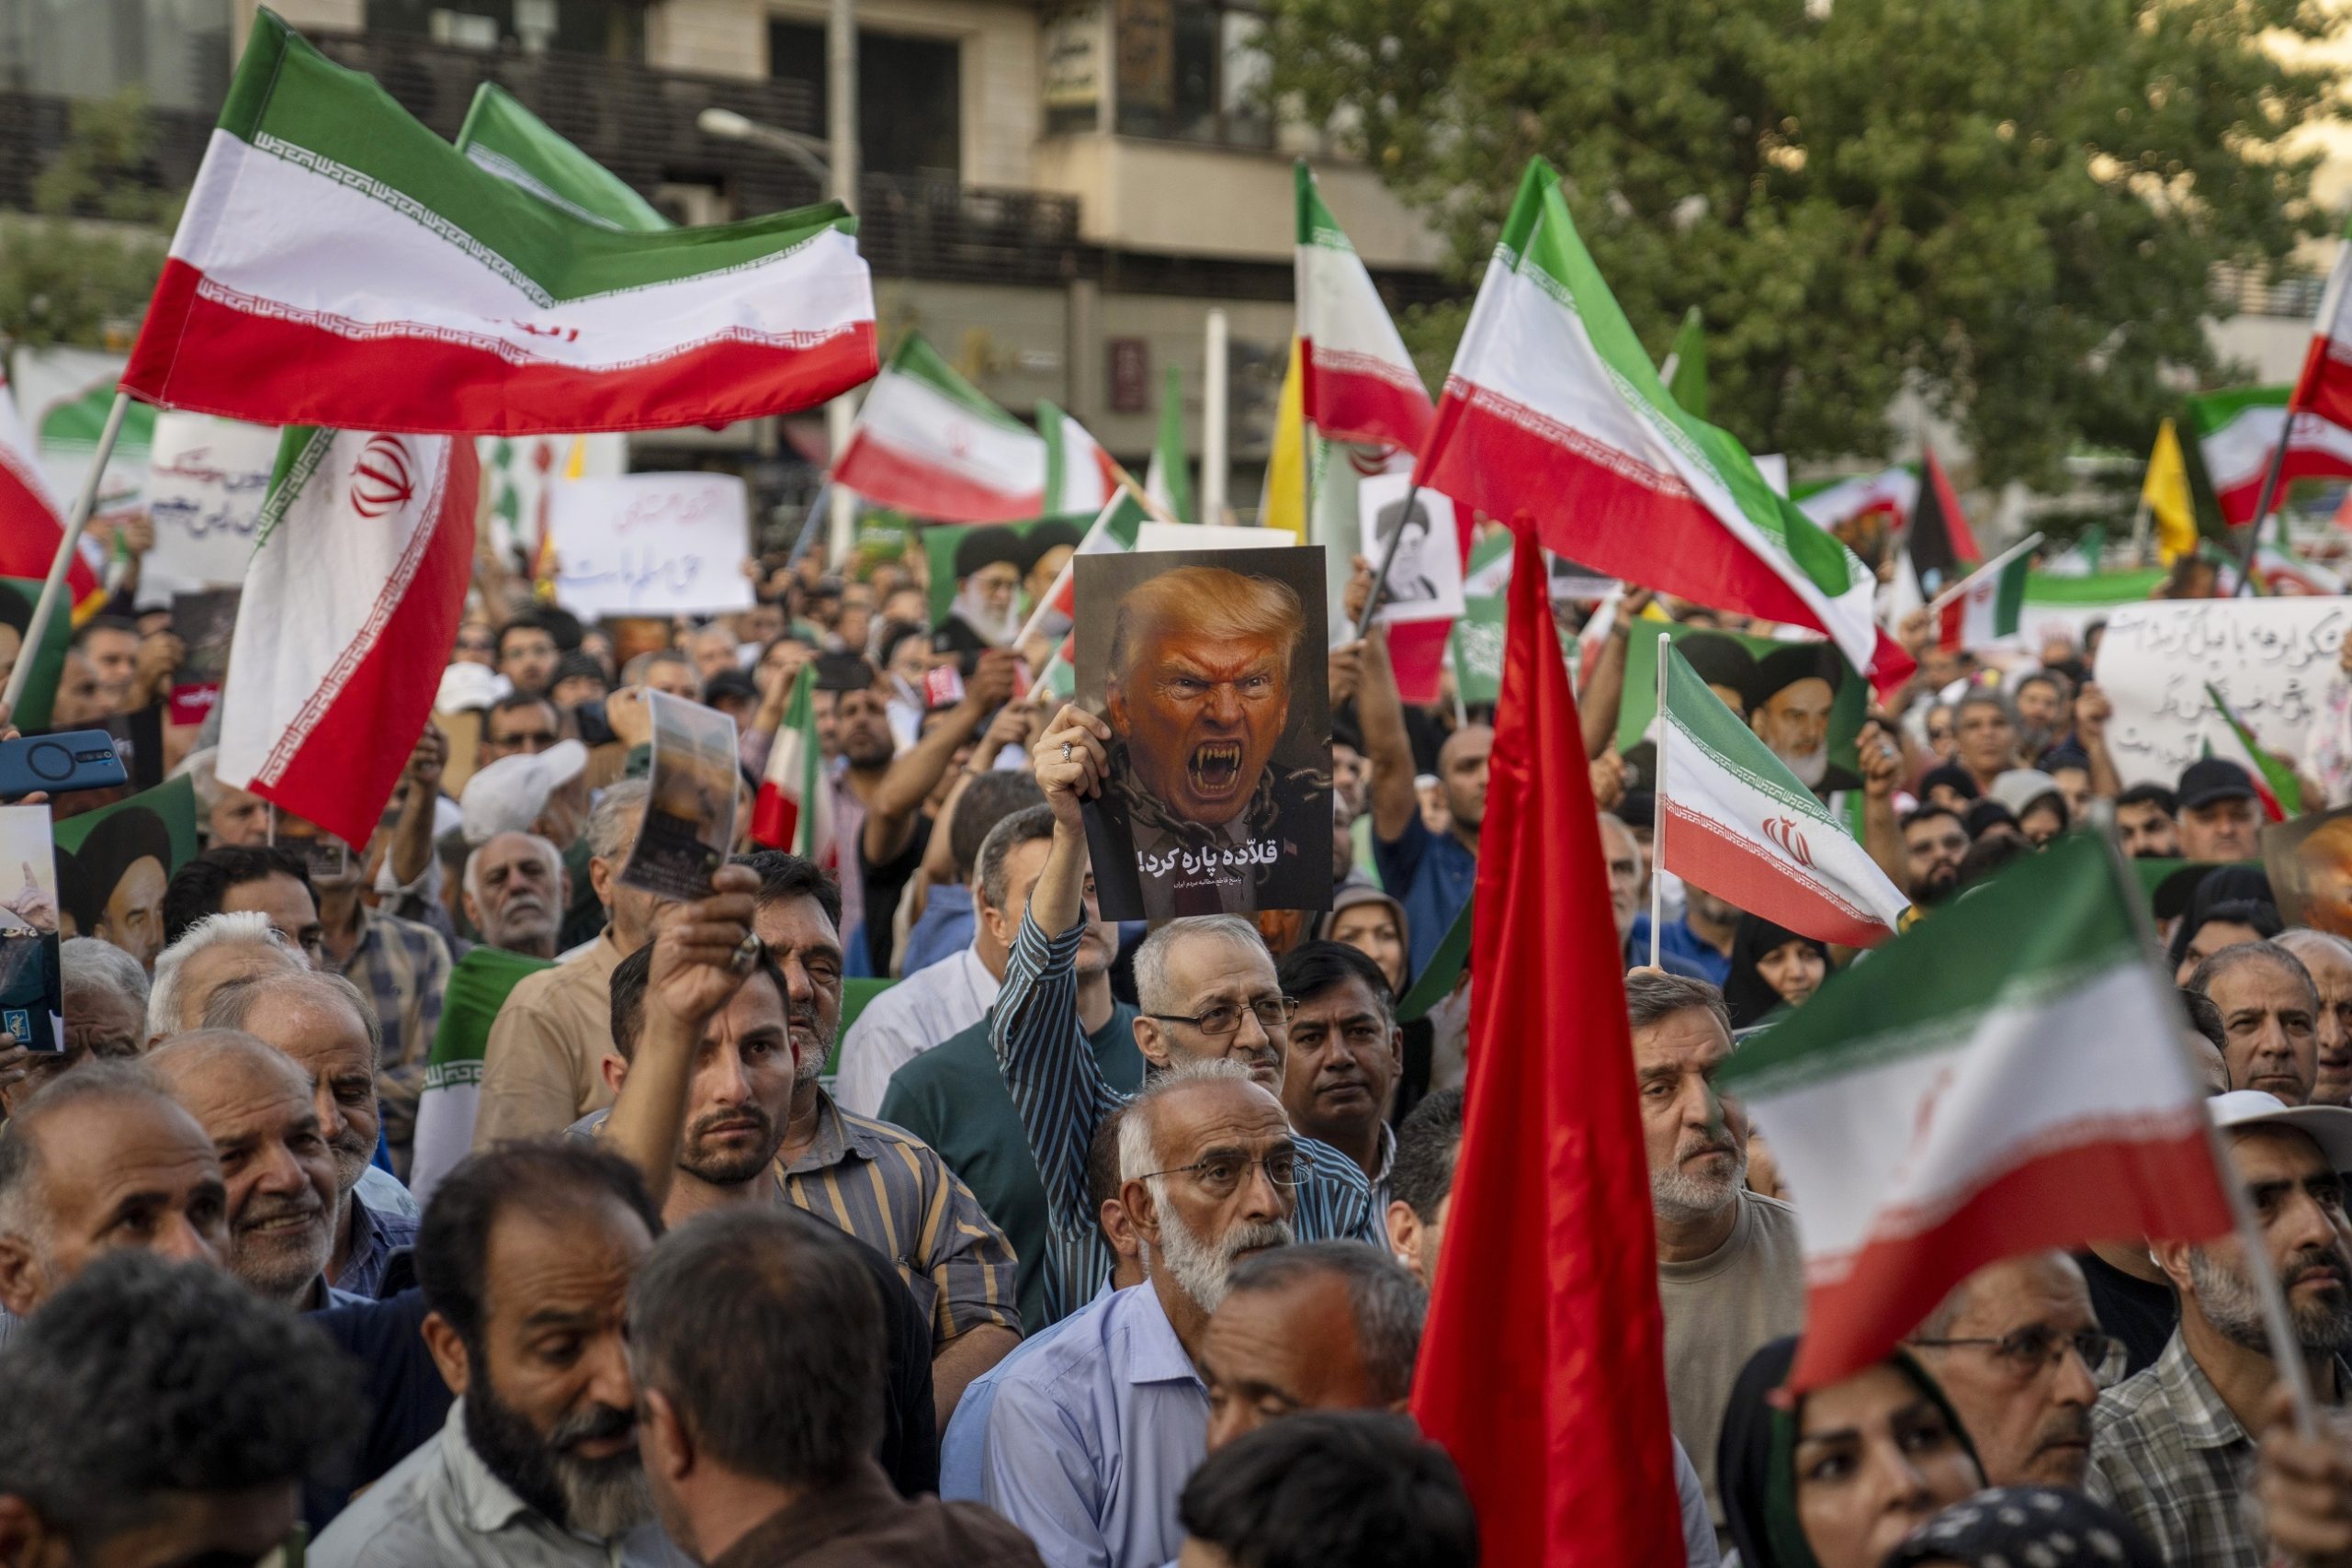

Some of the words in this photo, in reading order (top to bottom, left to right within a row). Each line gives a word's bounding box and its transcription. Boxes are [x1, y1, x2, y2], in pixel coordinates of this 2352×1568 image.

[1136, 848, 1180, 878] کرد!
[1182, 845, 1218, 876] پاره
[1173, 880, 1185, 888] ایران
[1186, 880, 1198, 888] مردم
[1228, 875, 1242, 886] پاسخ
